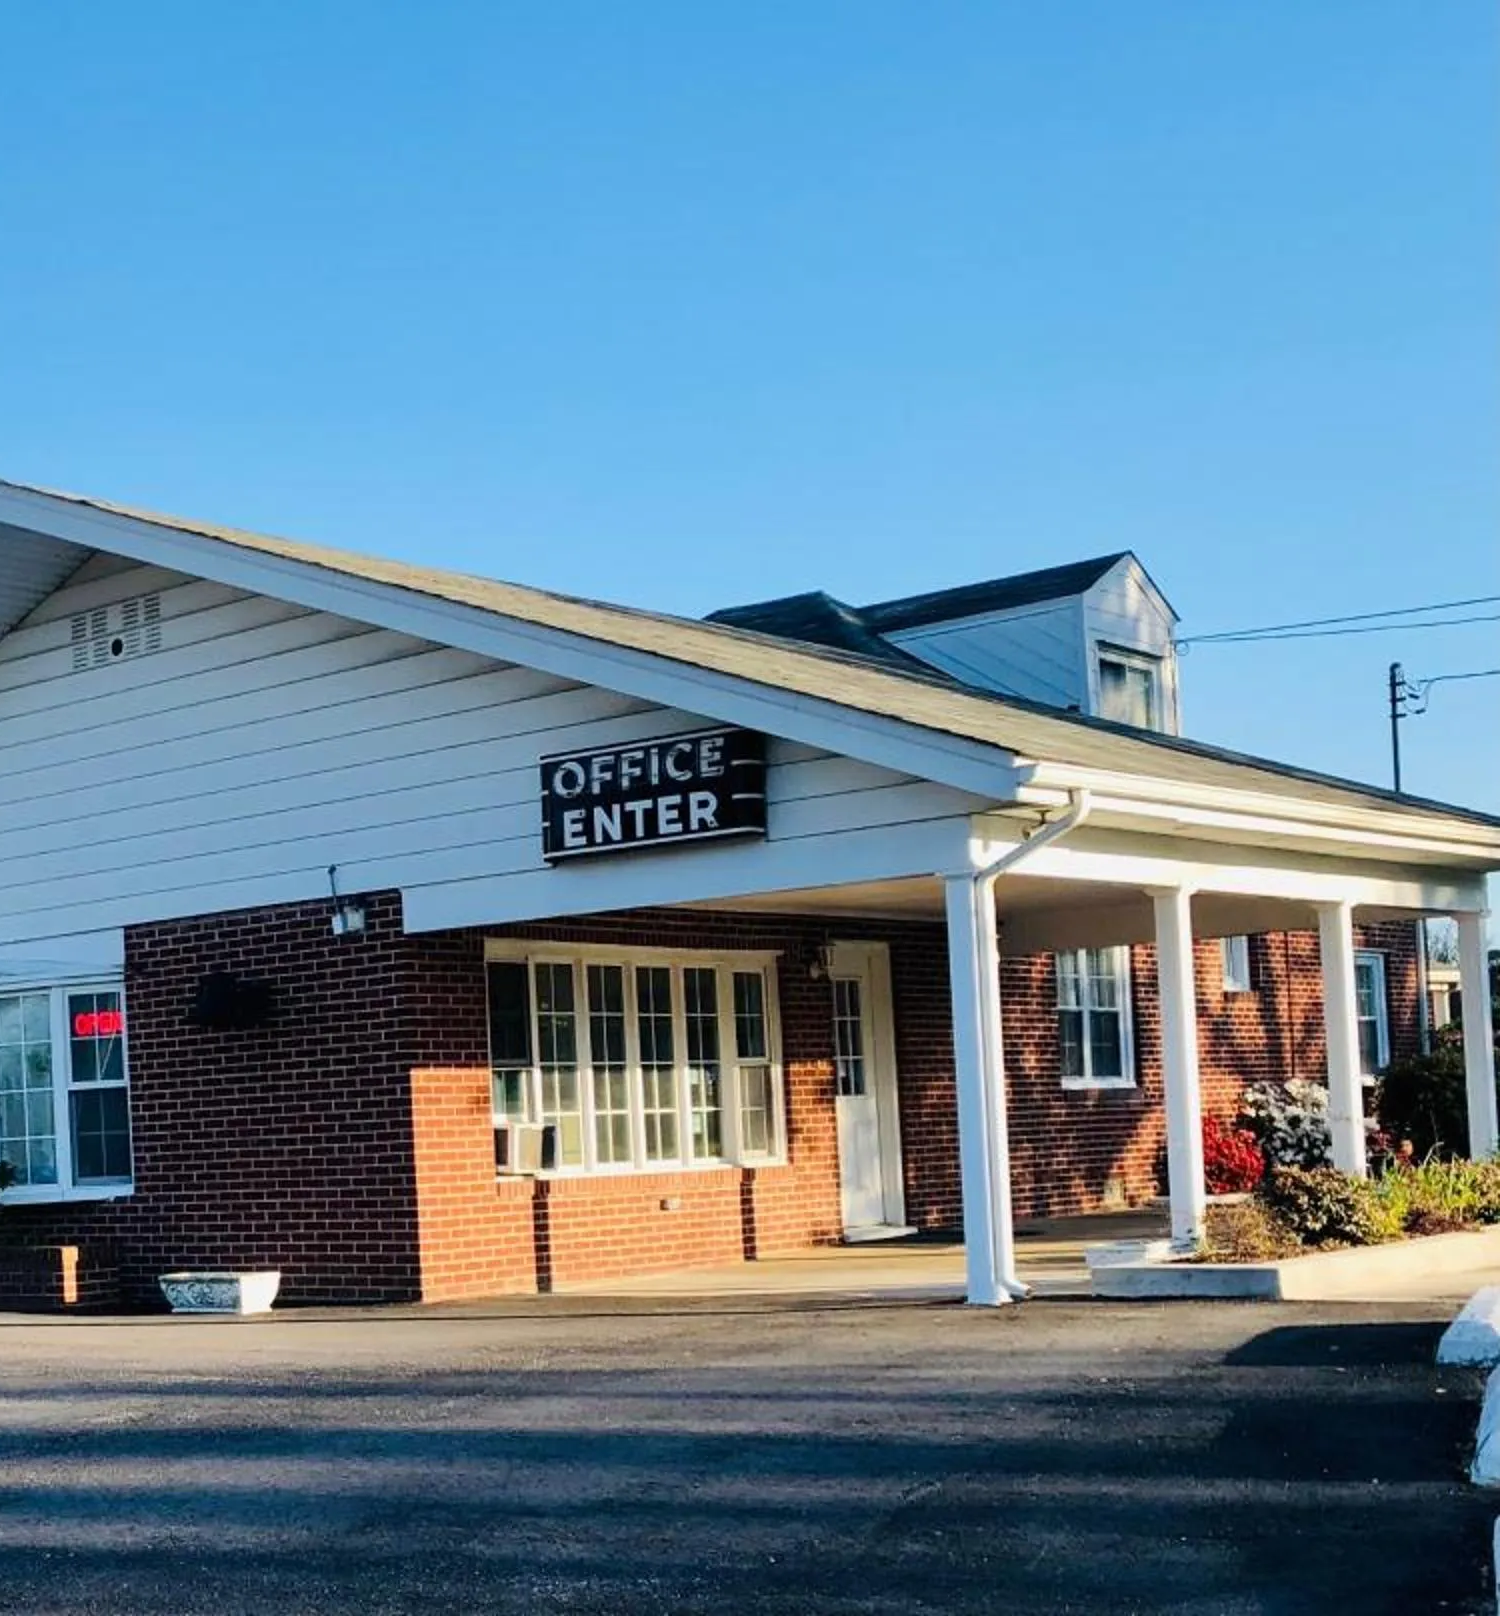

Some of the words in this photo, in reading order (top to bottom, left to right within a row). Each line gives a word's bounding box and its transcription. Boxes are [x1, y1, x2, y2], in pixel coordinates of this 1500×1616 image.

[553, 737, 725, 798] OFFICE
[563, 791, 720, 848] ENTER
[74, 1011, 124, 1035] OPEN
